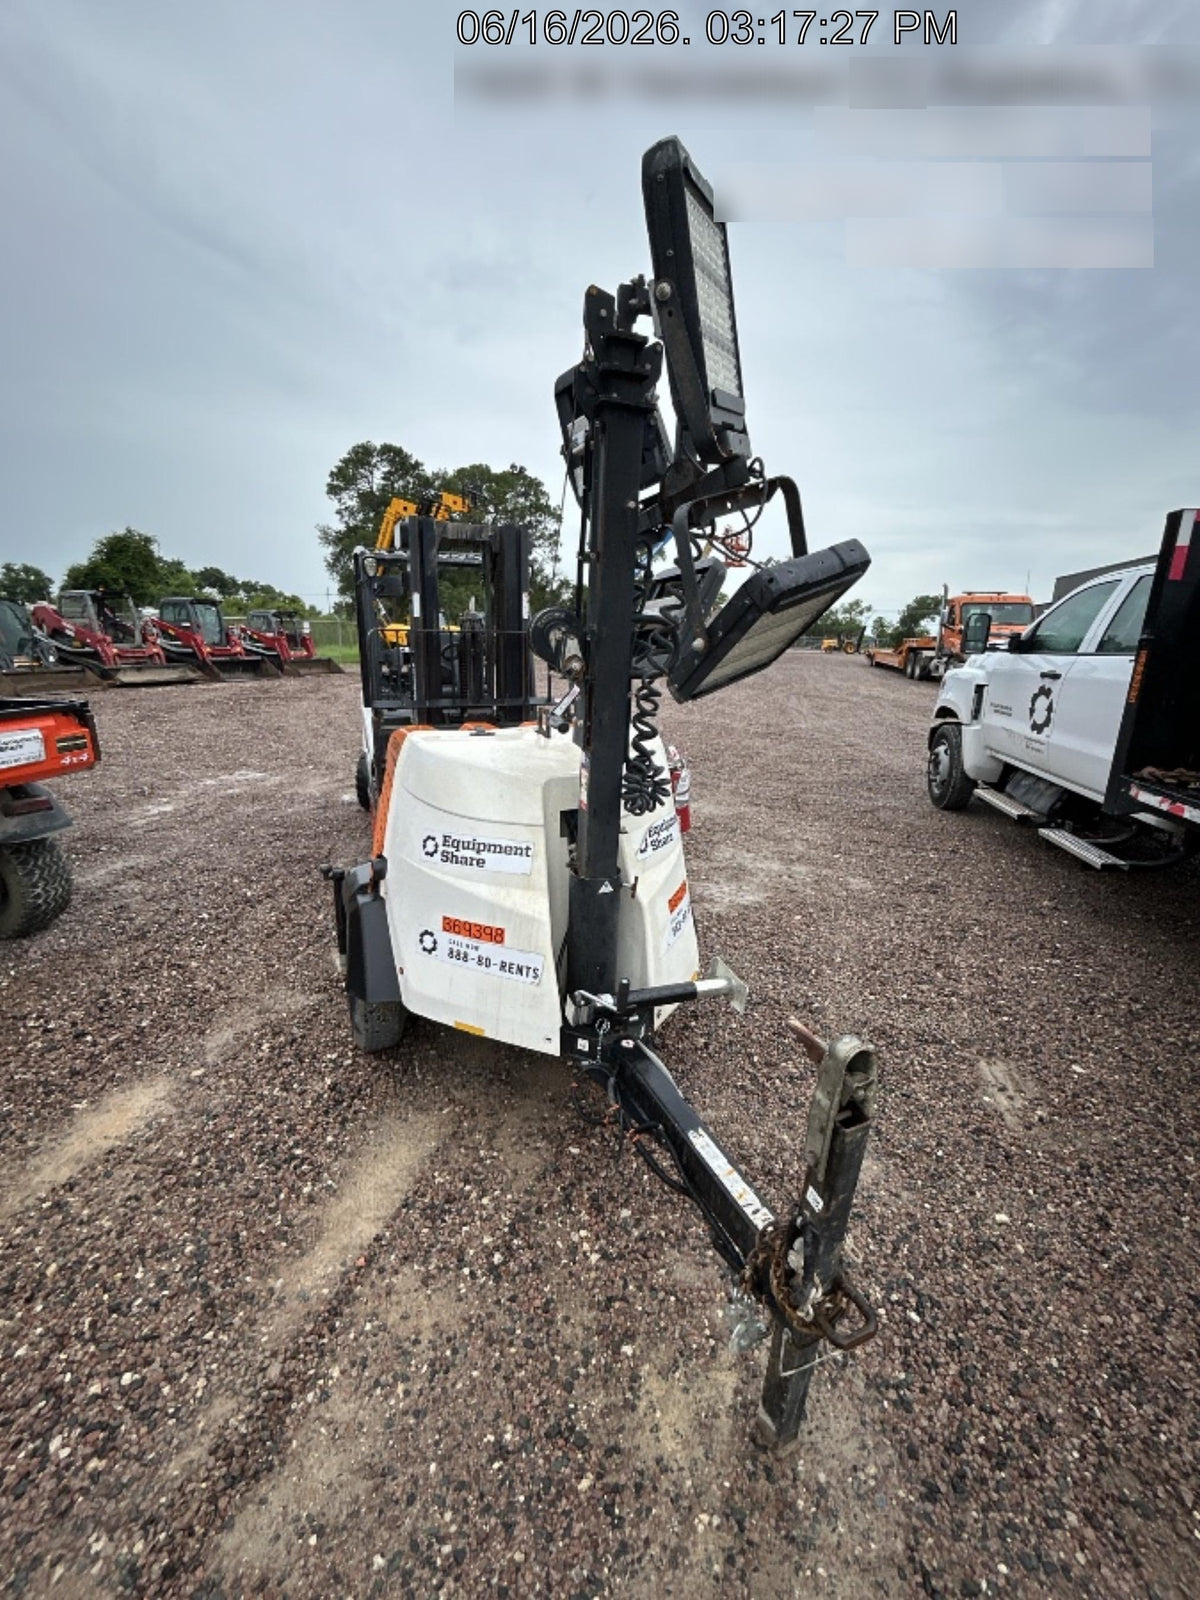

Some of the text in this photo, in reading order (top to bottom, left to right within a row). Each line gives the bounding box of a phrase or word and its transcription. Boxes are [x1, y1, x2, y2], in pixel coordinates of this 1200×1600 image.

[441, 834, 532, 857] Equipment
[440, 849, 486, 868] Share
[442, 916, 505, 944] 369398
[447, 947, 540, 980] 888-80-RENTS
